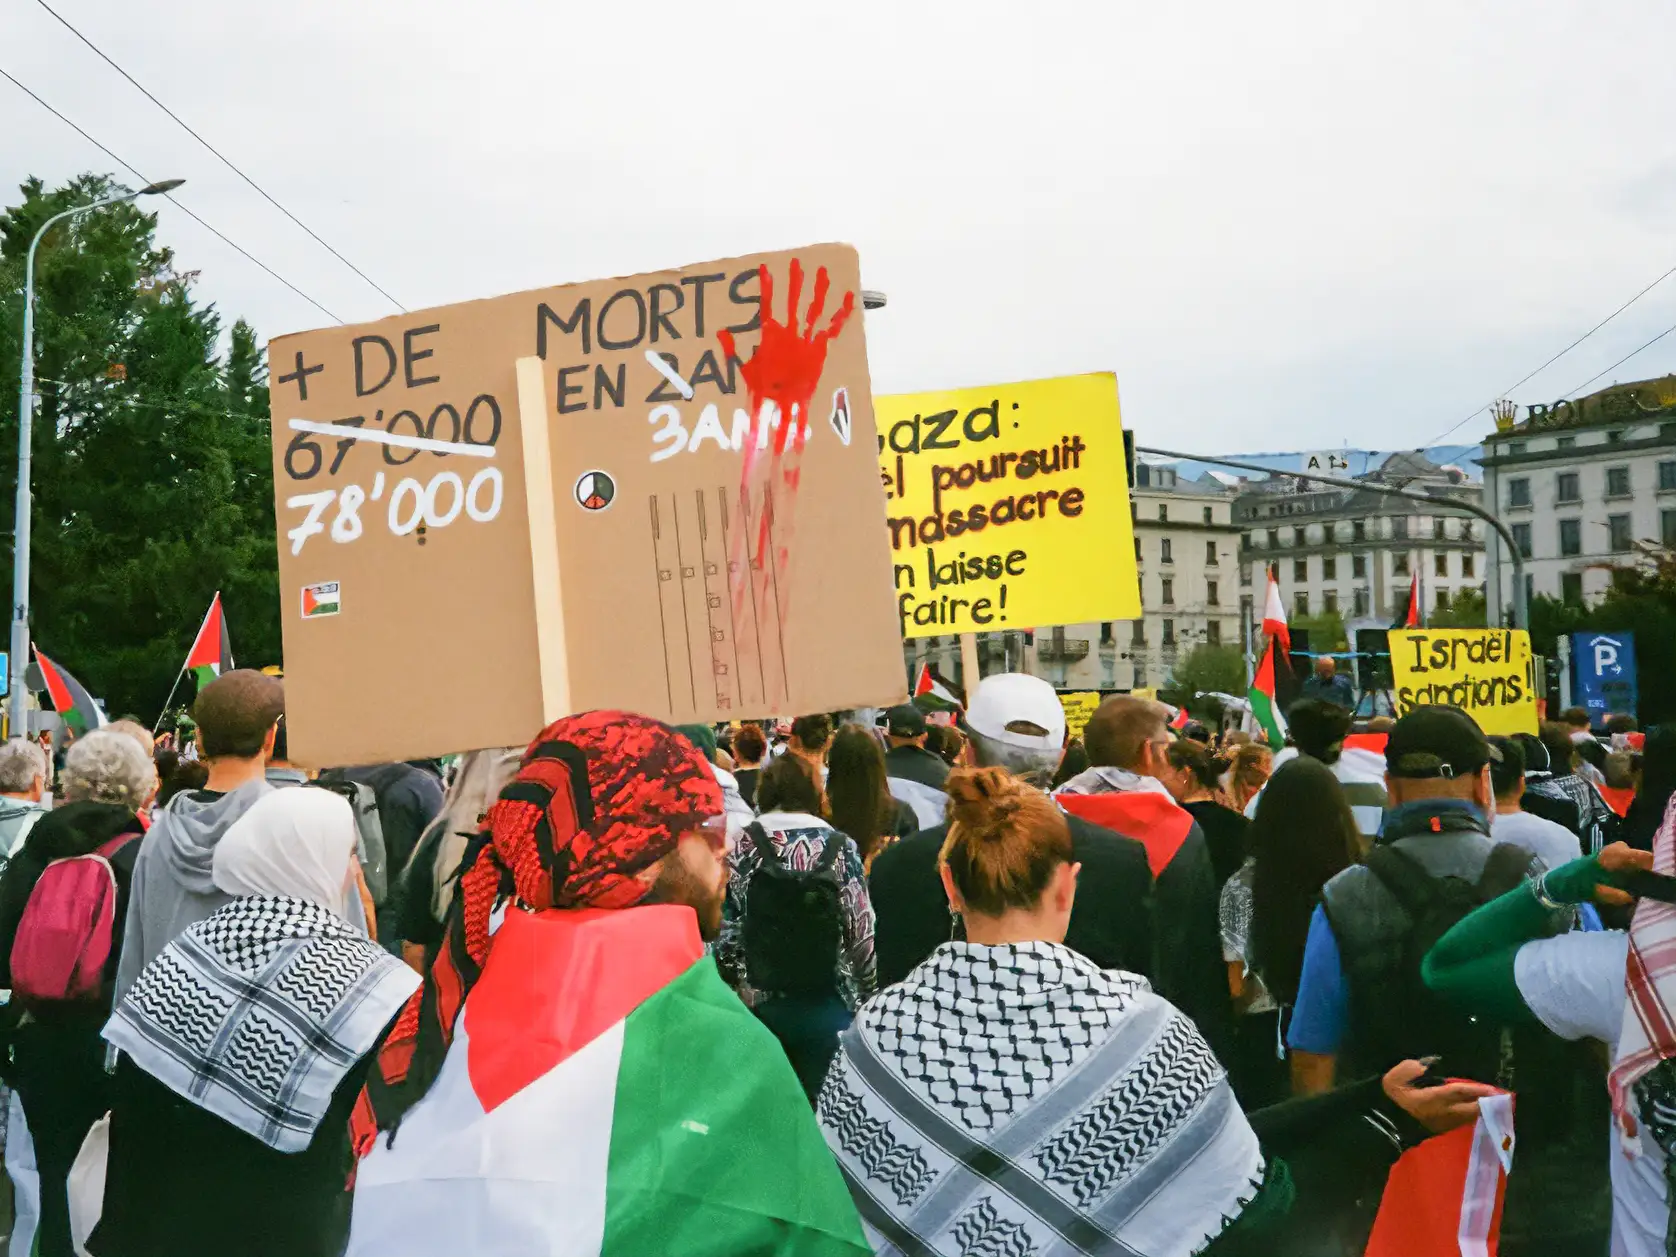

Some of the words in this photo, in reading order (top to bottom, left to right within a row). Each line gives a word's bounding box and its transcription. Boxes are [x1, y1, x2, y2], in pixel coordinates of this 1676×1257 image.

[536, 268, 762, 360] MORTS
[352, 323, 440, 397] DE
[557, 363, 626, 414] EN
[877, 399, 1020, 455] aza:
[931, 435, 1086, 514] poursuit
[286, 466, 503, 556] 78'000
[927, 547, 1027, 590] laisse
[899, 584, 1008, 637] faire!
[1594, 644, 1618, 676] P
